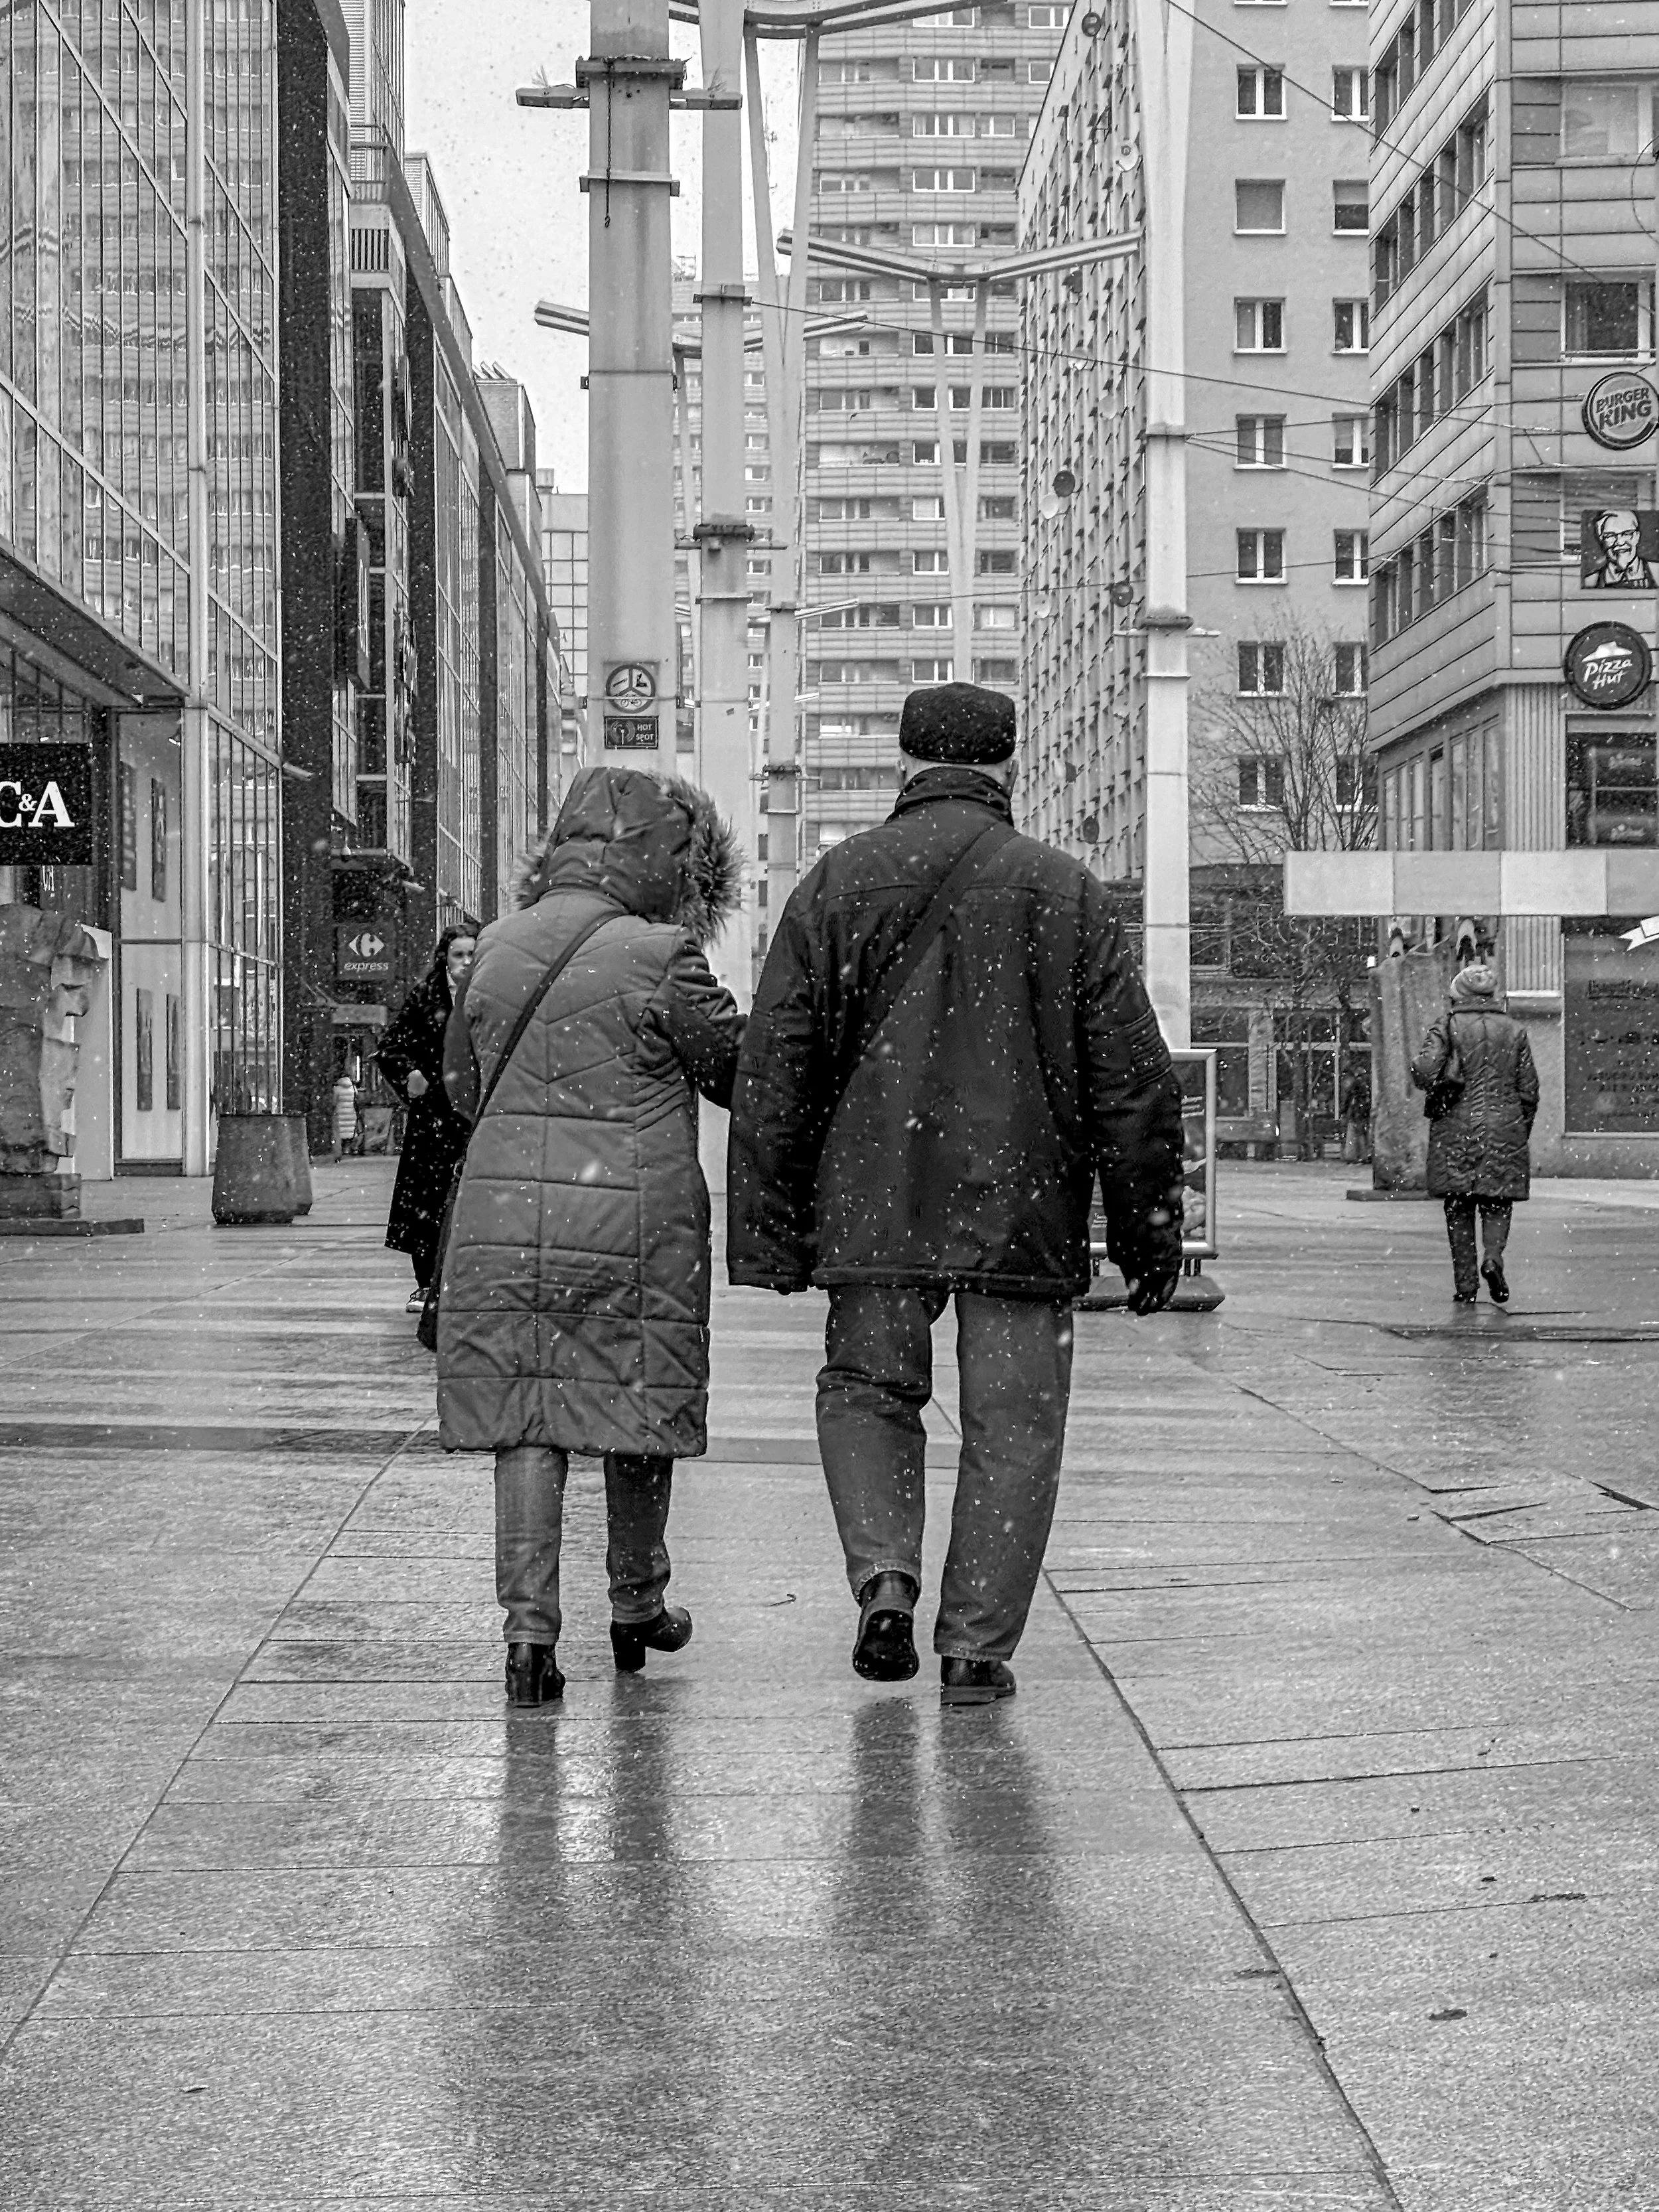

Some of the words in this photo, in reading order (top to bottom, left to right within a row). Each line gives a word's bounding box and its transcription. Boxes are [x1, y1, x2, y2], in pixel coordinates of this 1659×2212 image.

[1596, 388, 1649, 413] BURGER
[1599, 400, 1652, 430] KING
[1583, 658, 1632, 682] Pizza
[1593, 670, 1628, 690] Hut
[0, 780, 75, 828] C&A
[344, 962, 389, 973] express
